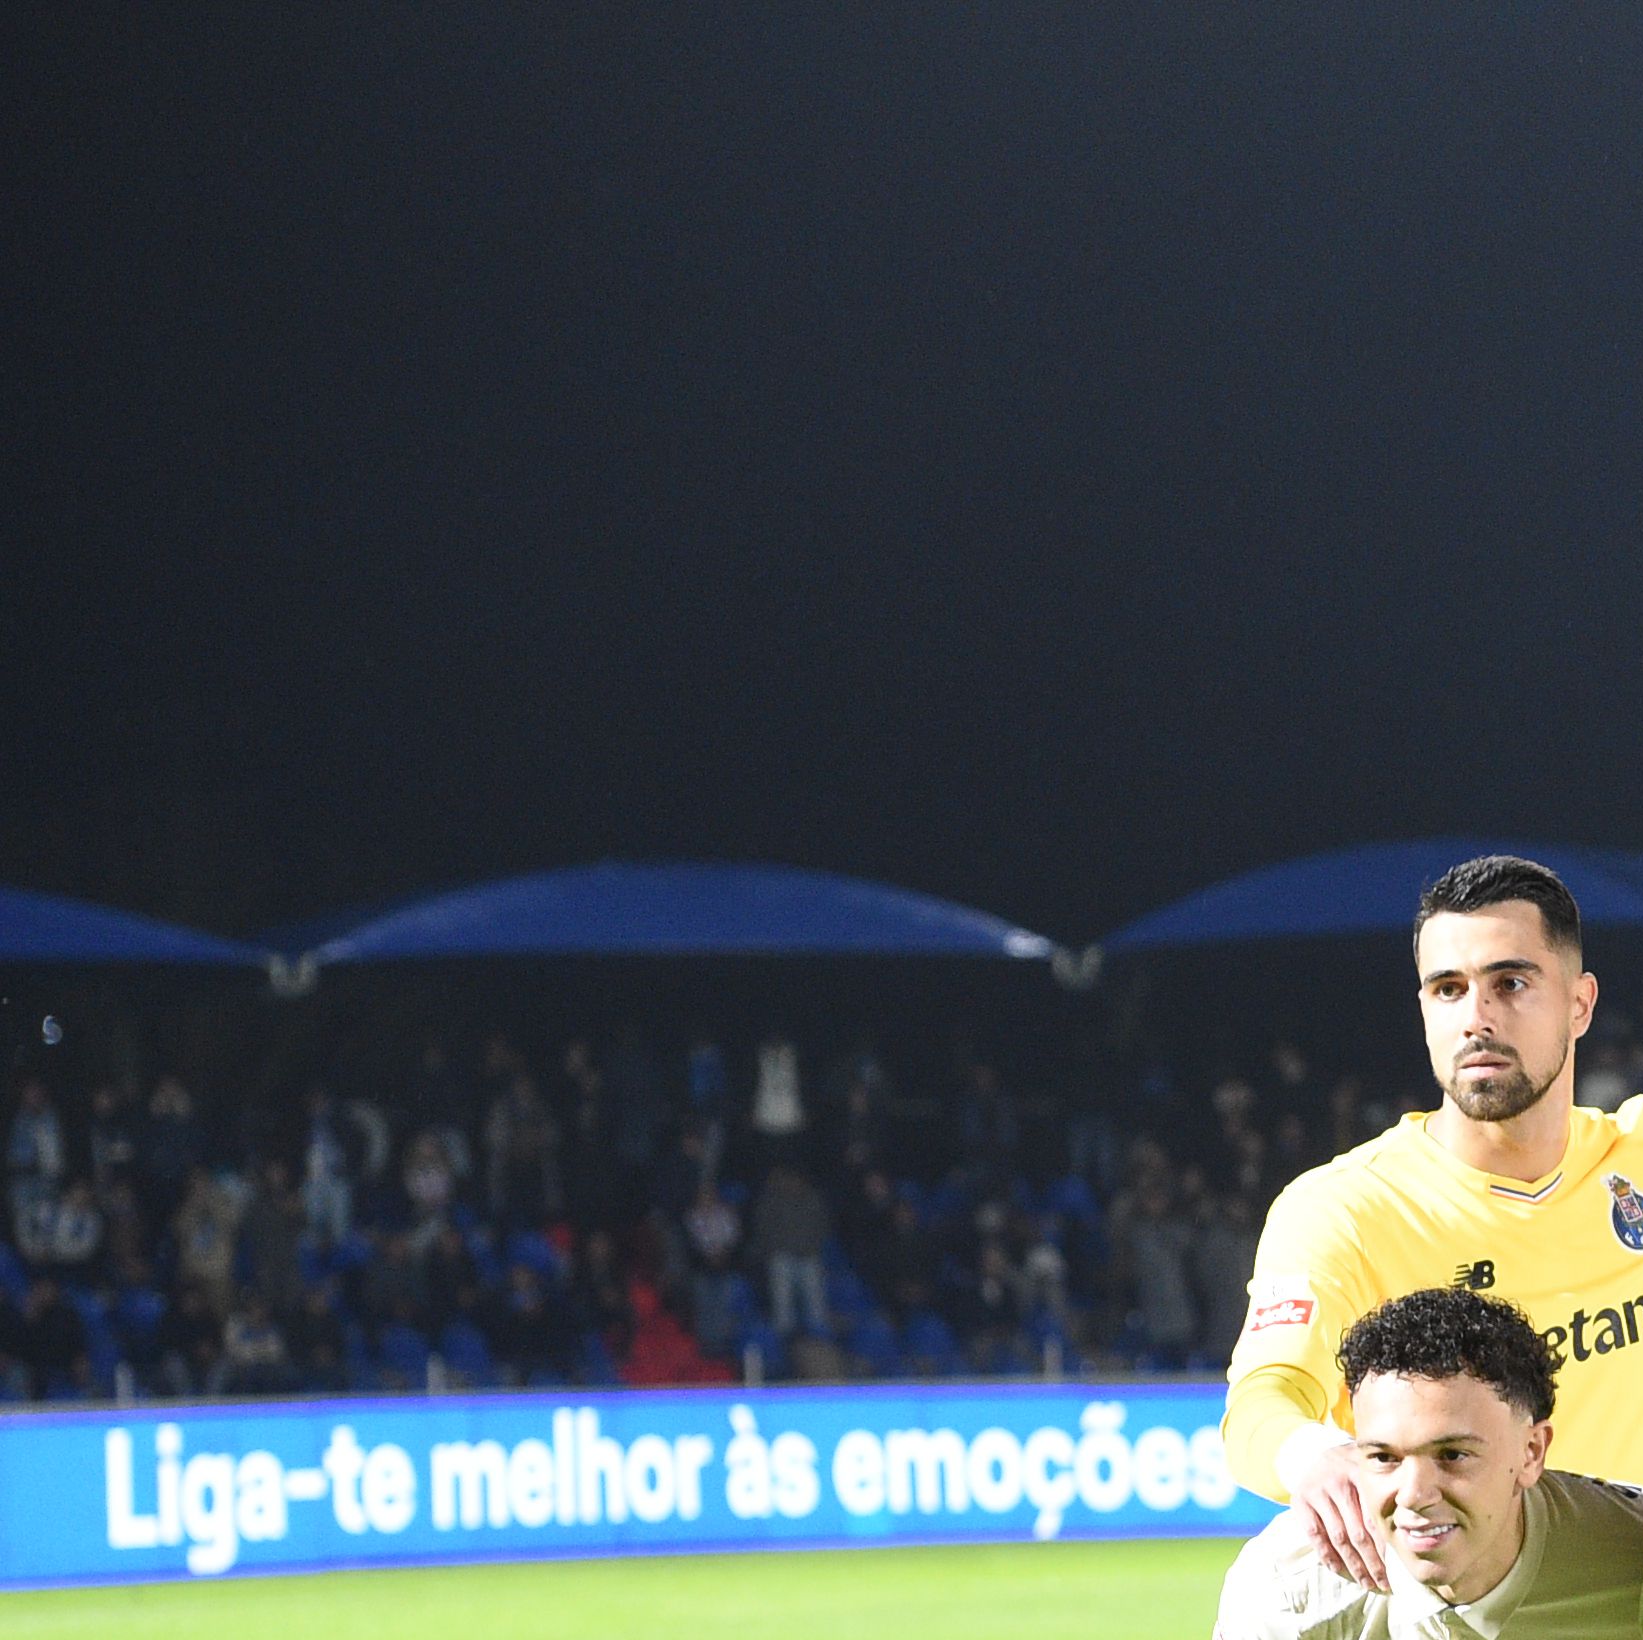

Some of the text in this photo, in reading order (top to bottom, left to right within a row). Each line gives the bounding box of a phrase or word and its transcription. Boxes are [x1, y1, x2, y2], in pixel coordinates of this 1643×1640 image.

[106, 1401, 1237, 1576] Liga-te melhor às emoções
